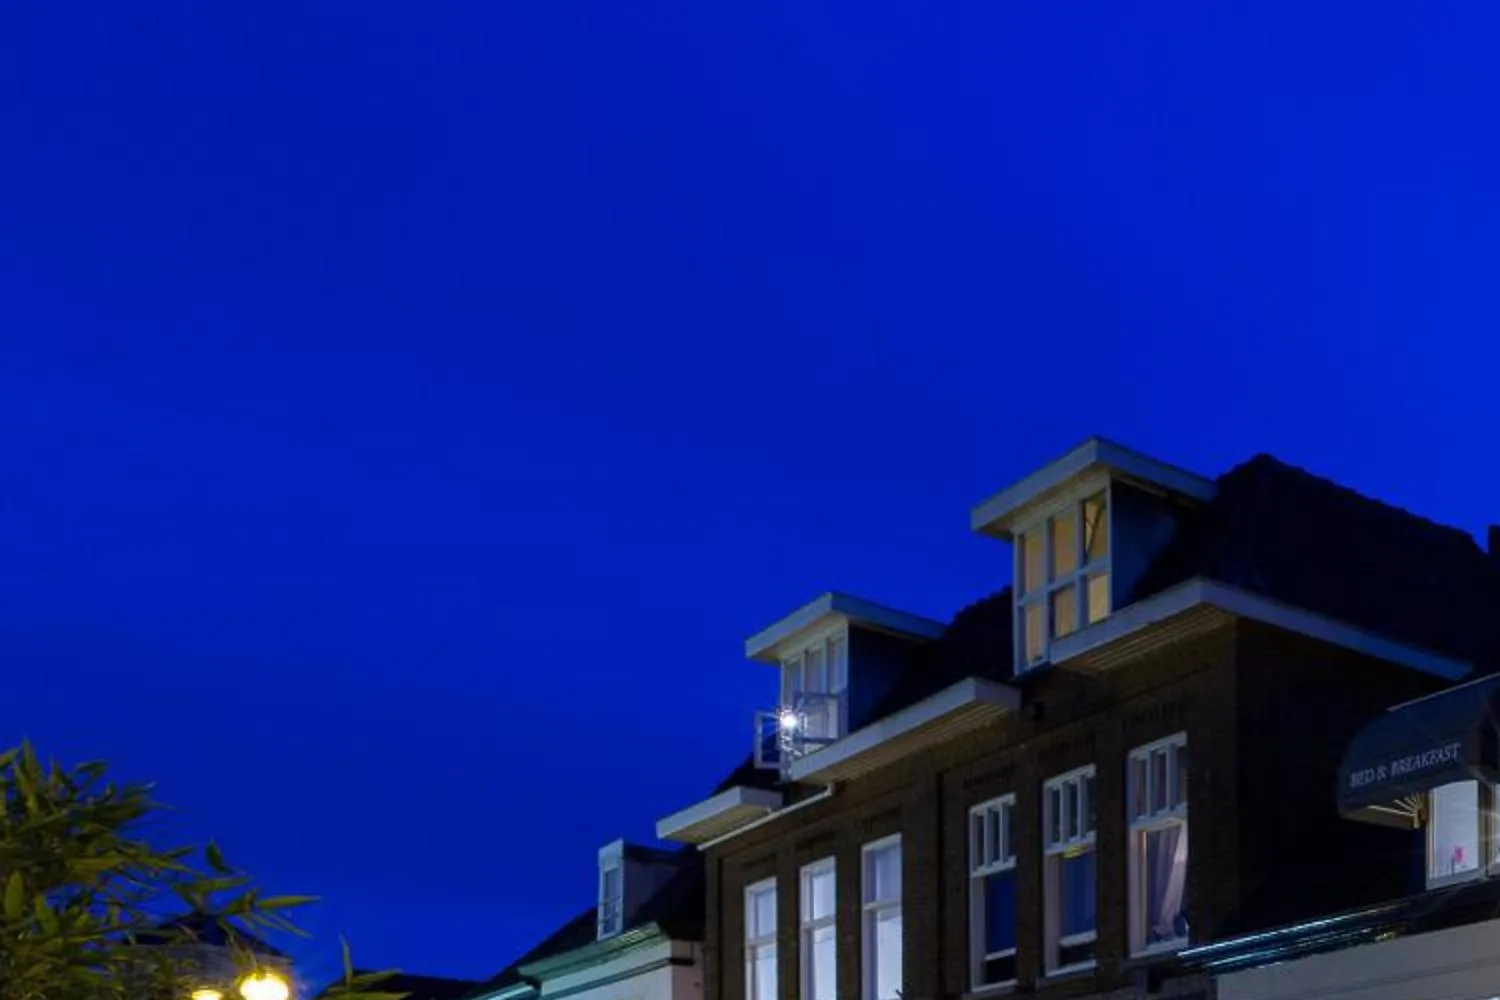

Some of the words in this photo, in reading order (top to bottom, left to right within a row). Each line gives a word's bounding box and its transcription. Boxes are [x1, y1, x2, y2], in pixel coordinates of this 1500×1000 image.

[1350, 767, 1375, 788] BED
[1377, 763, 1388, 780] &
[1390, 742, 1462, 775] BREAKFAST
